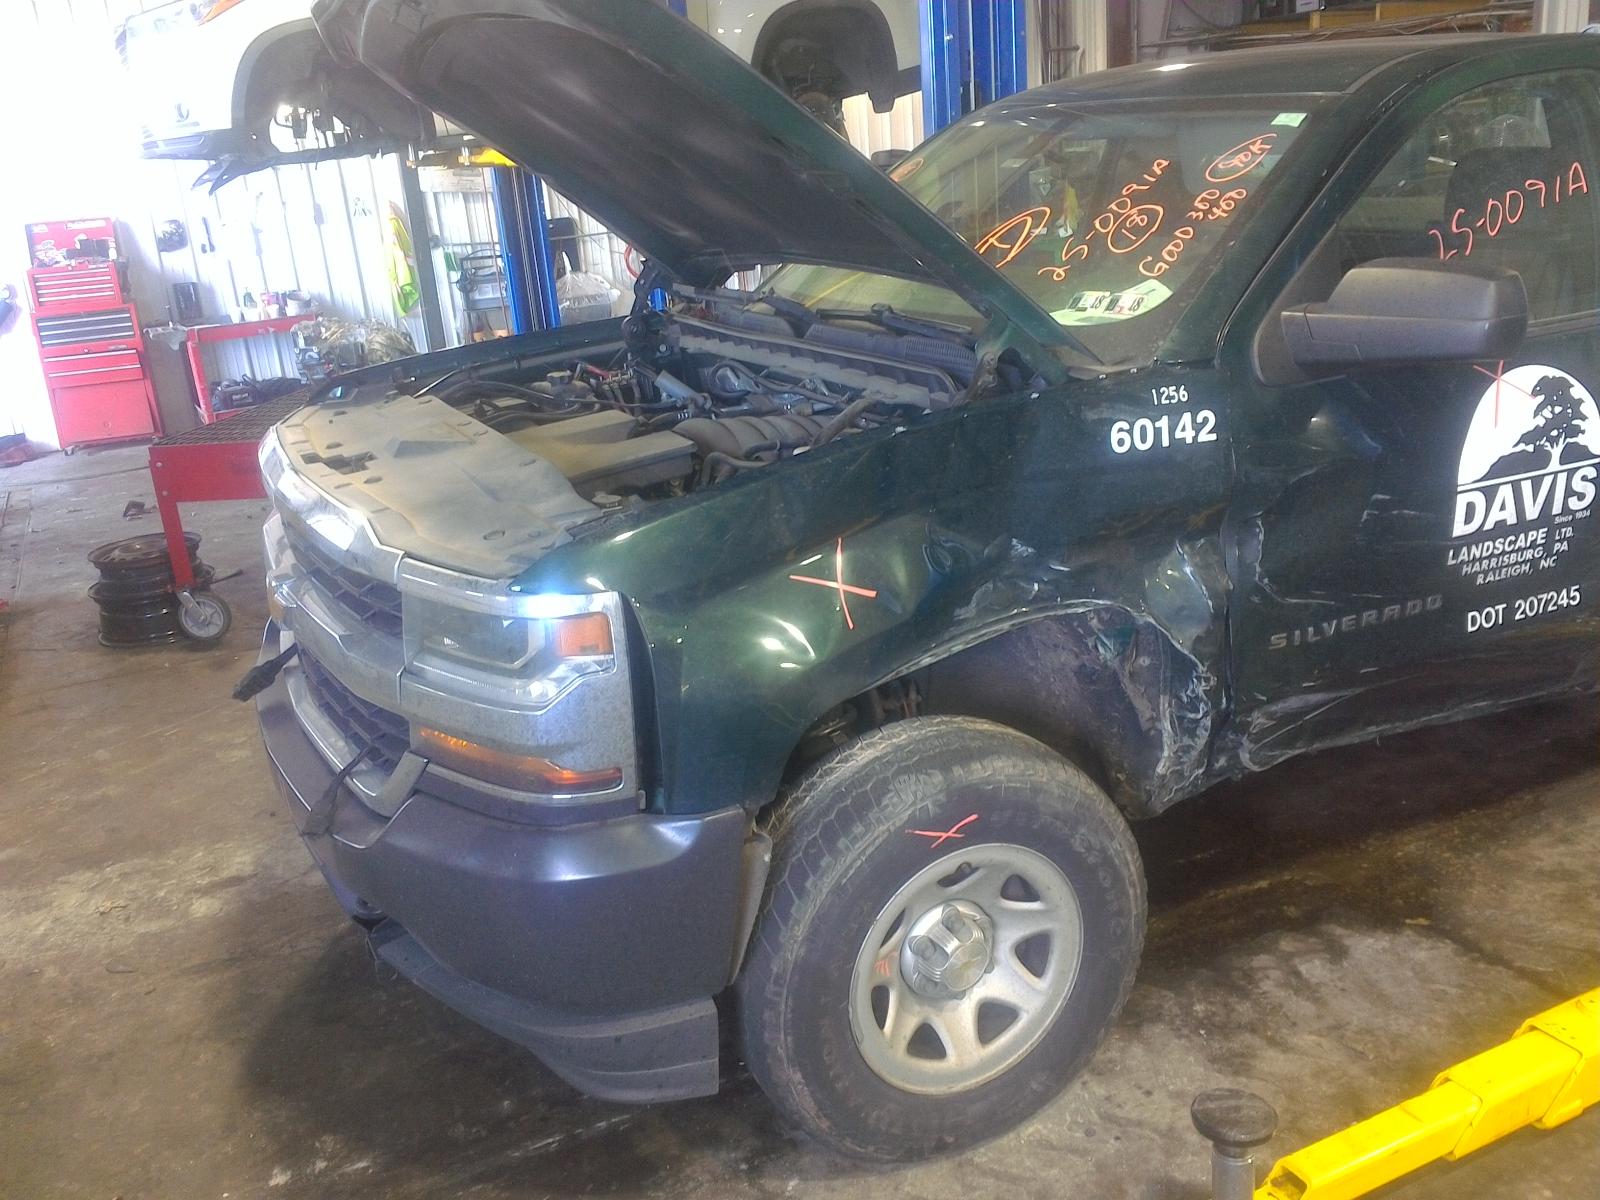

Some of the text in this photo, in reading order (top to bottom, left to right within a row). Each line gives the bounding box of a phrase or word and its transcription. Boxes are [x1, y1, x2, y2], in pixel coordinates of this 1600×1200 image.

[1037, 157, 1171, 282] 25-0091A
[1428, 161, 1588, 261] 25-0091A
[1151, 384, 1189, 406] 1256
[1110, 409, 1218, 454] 60142
[1452, 466, 1598, 538] DAVIS
[1554, 513, 1573, 525] Since
[1447, 526, 1574, 566] LANDSCAPE LTD.
[1461, 540, 1569, 577] HARRISBURG, PA
[1476, 556, 1558, 586] RALEIGH, NC
[1268, 594, 1443, 650] SILVERADO
[1467, 584, 1581, 633] DOT 207245
